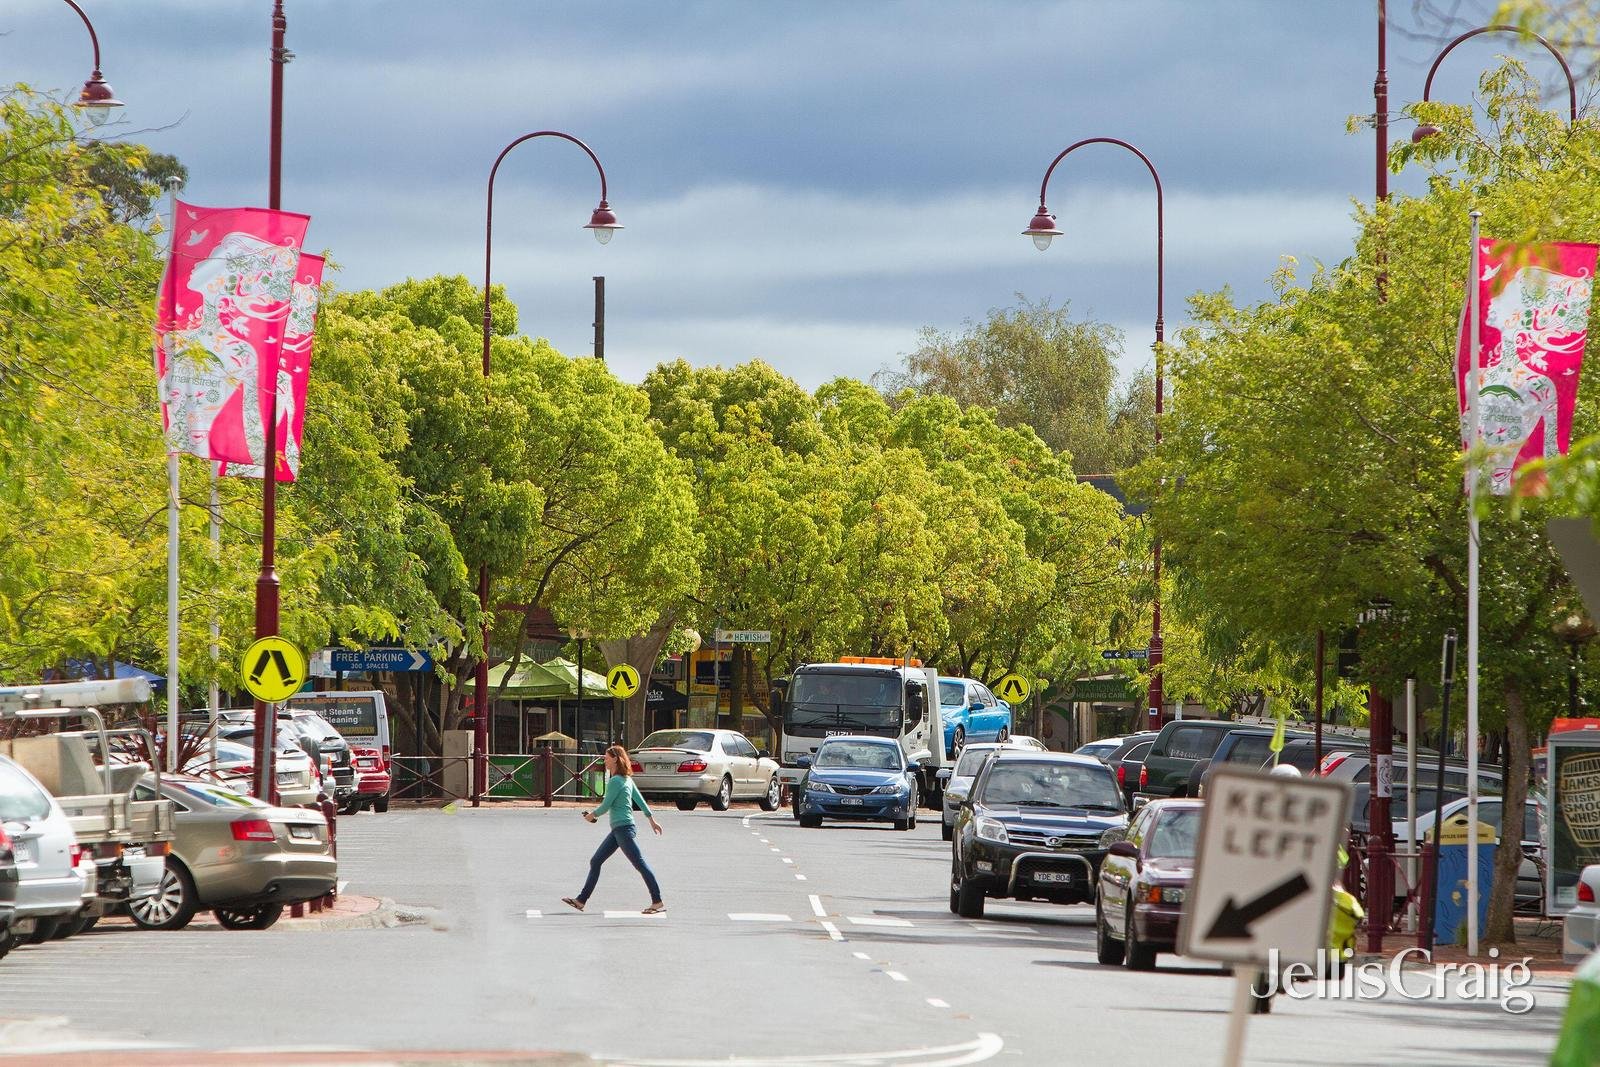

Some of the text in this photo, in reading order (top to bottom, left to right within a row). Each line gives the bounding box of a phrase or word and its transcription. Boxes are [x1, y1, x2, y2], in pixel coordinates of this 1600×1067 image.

[734, 633, 762, 641] HEWISH
[336, 653, 404, 662] FREE PARKING
[1075, 681, 1124, 692] NATIONAL
[329, 708, 354, 716] Steam
[356, 707, 362, 715] &
[325, 716, 359, 725] Cleaning
[1562, 776, 1600, 790] JAMES
[1562, 793, 1595, 803] IRISH
[1225, 789, 1330, 822] KEEP
[1223, 825, 1320, 861] LEFT
